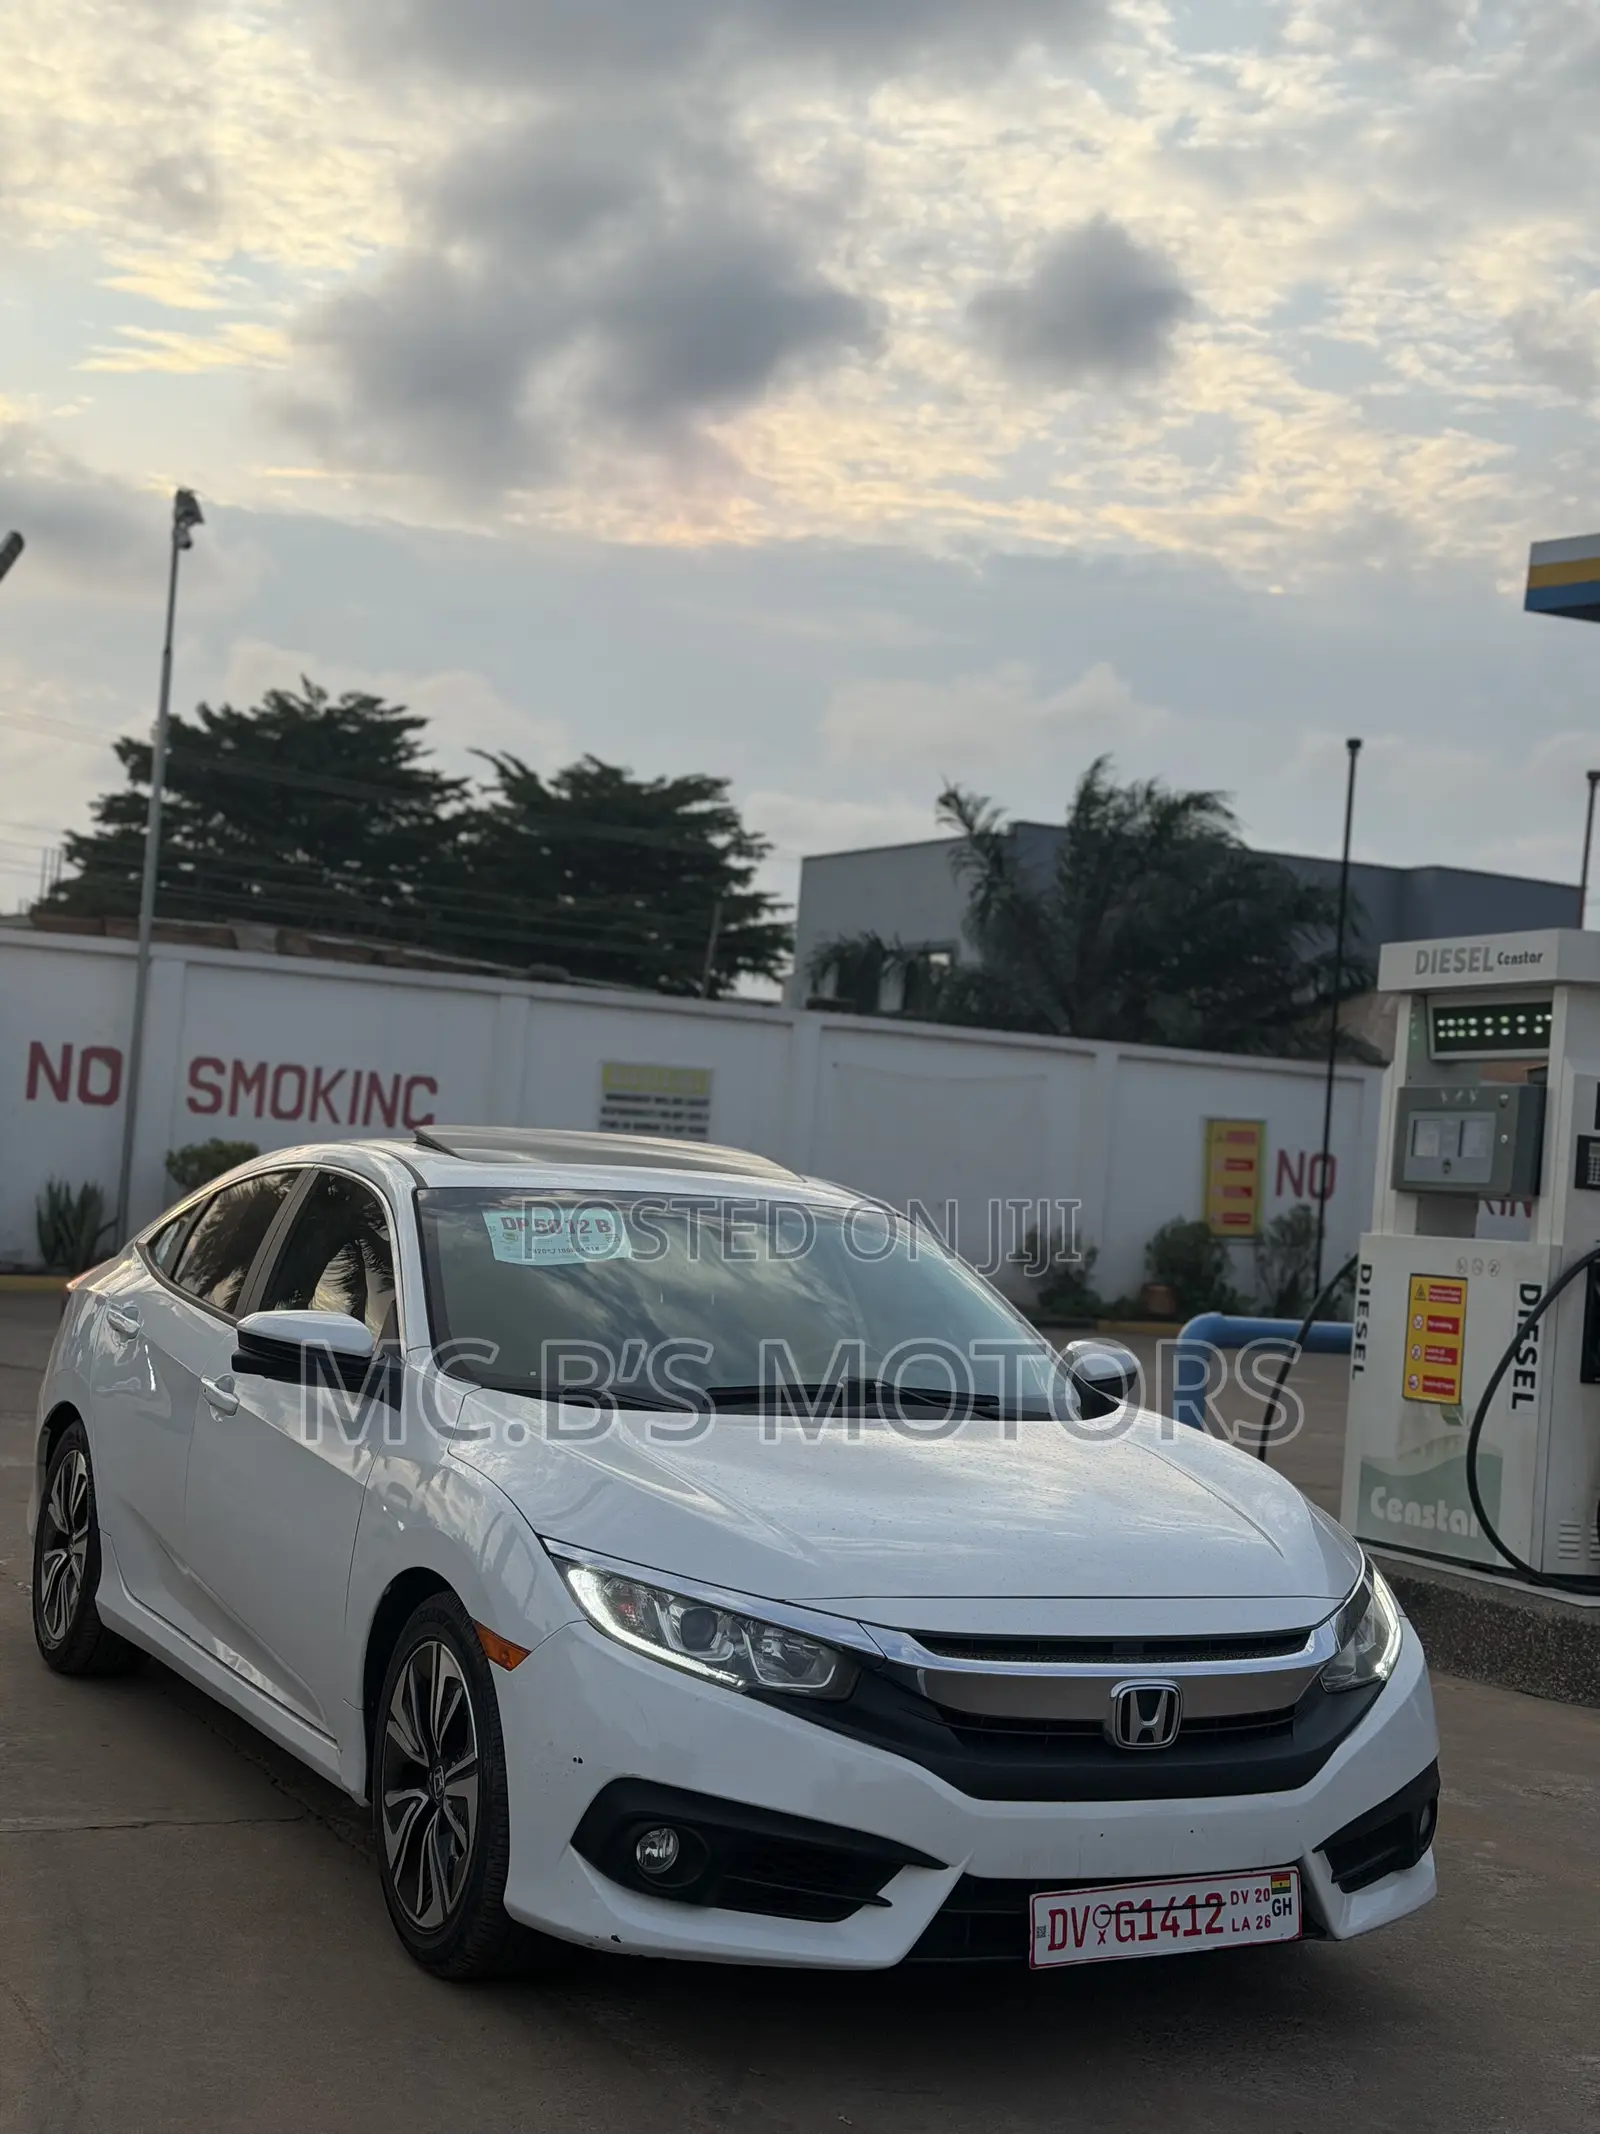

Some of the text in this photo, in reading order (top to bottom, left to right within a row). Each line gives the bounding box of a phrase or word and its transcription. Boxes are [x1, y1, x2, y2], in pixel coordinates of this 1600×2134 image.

[1415, 946, 1495, 975] DIESEL
[26, 1041, 124, 1106] NO
[1275, 1149, 1337, 1200] NO
[1351, 1263, 1373, 1381] DIESEL
[1511, 1282, 1543, 1411] DIESEL
[1048, 1892, 1225, 1952] DV G1412
[1230, 1887, 1271, 1906] DV 20
[1271, 1897, 1293, 1918] GH
[1232, 1913, 1272, 1933] LA 26
